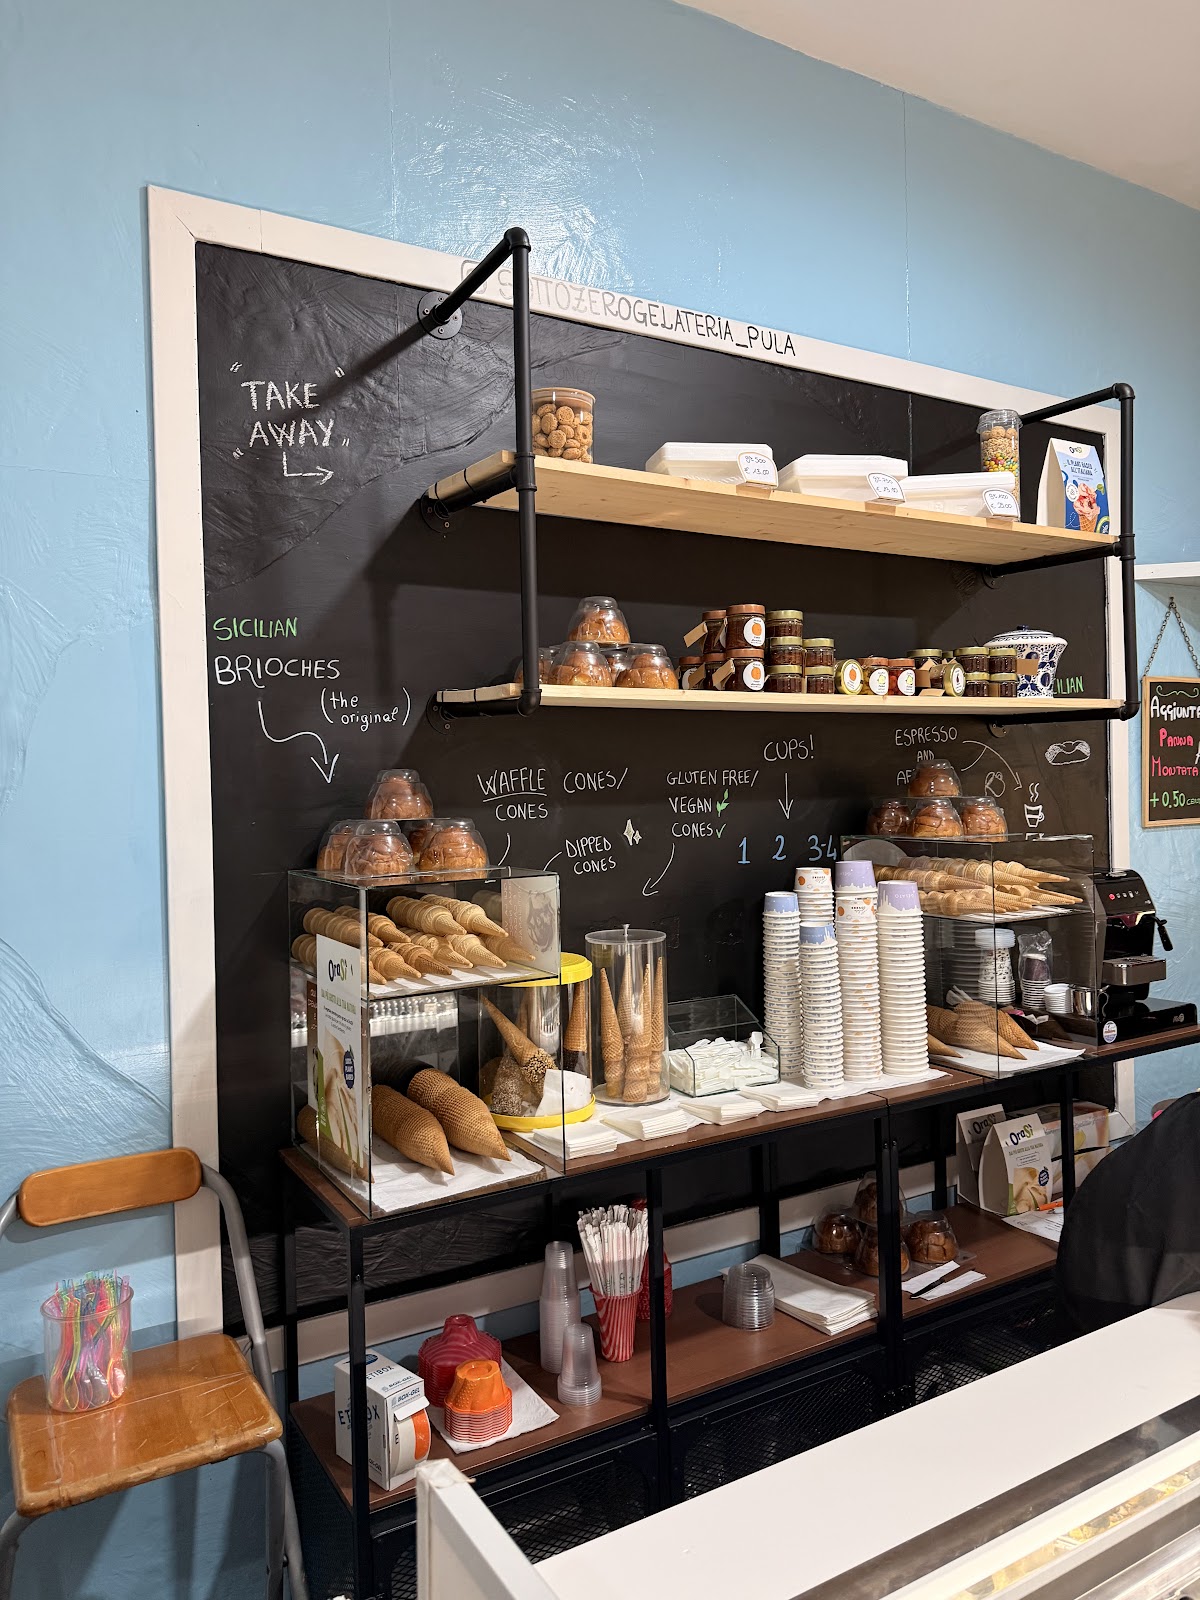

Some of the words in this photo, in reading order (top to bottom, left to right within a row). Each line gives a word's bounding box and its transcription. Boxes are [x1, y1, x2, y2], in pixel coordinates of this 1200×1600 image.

[213, 617, 298, 641] SICILIAN
[215, 654, 341, 688] BRIOCHES
[1054, 675, 1084, 695] ILIAN
[895, 725, 958, 747] ESPRESSO
[763, 734, 814, 762] CUPS!
[917, 750, 935, 763] AND
[477, 767, 547, 796] WAFFLE
[563, 767, 629, 793] CONES/
[666, 770, 718, 785] GLUTEN
[722, 770, 759, 787] FREE/
[896, 769, 916, 786] AF
[668, 796, 712, 814] VEGAN
[1161, 790, 1186, 809] 0.50
[495, 803, 548, 821] CONES
[671, 822, 714, 839] CONES
[565, 836, 612, 858] DIPPED
[738, 836, 751, 865] 1
[772, 834, 787, 861] 2
[807, 834, 838, 861] 3-4
[573, 856, 617, 875] CONES
[397, 1387, 421, 1403] BOX-GEL
[337, 1404, 381, 1425] ETOX
